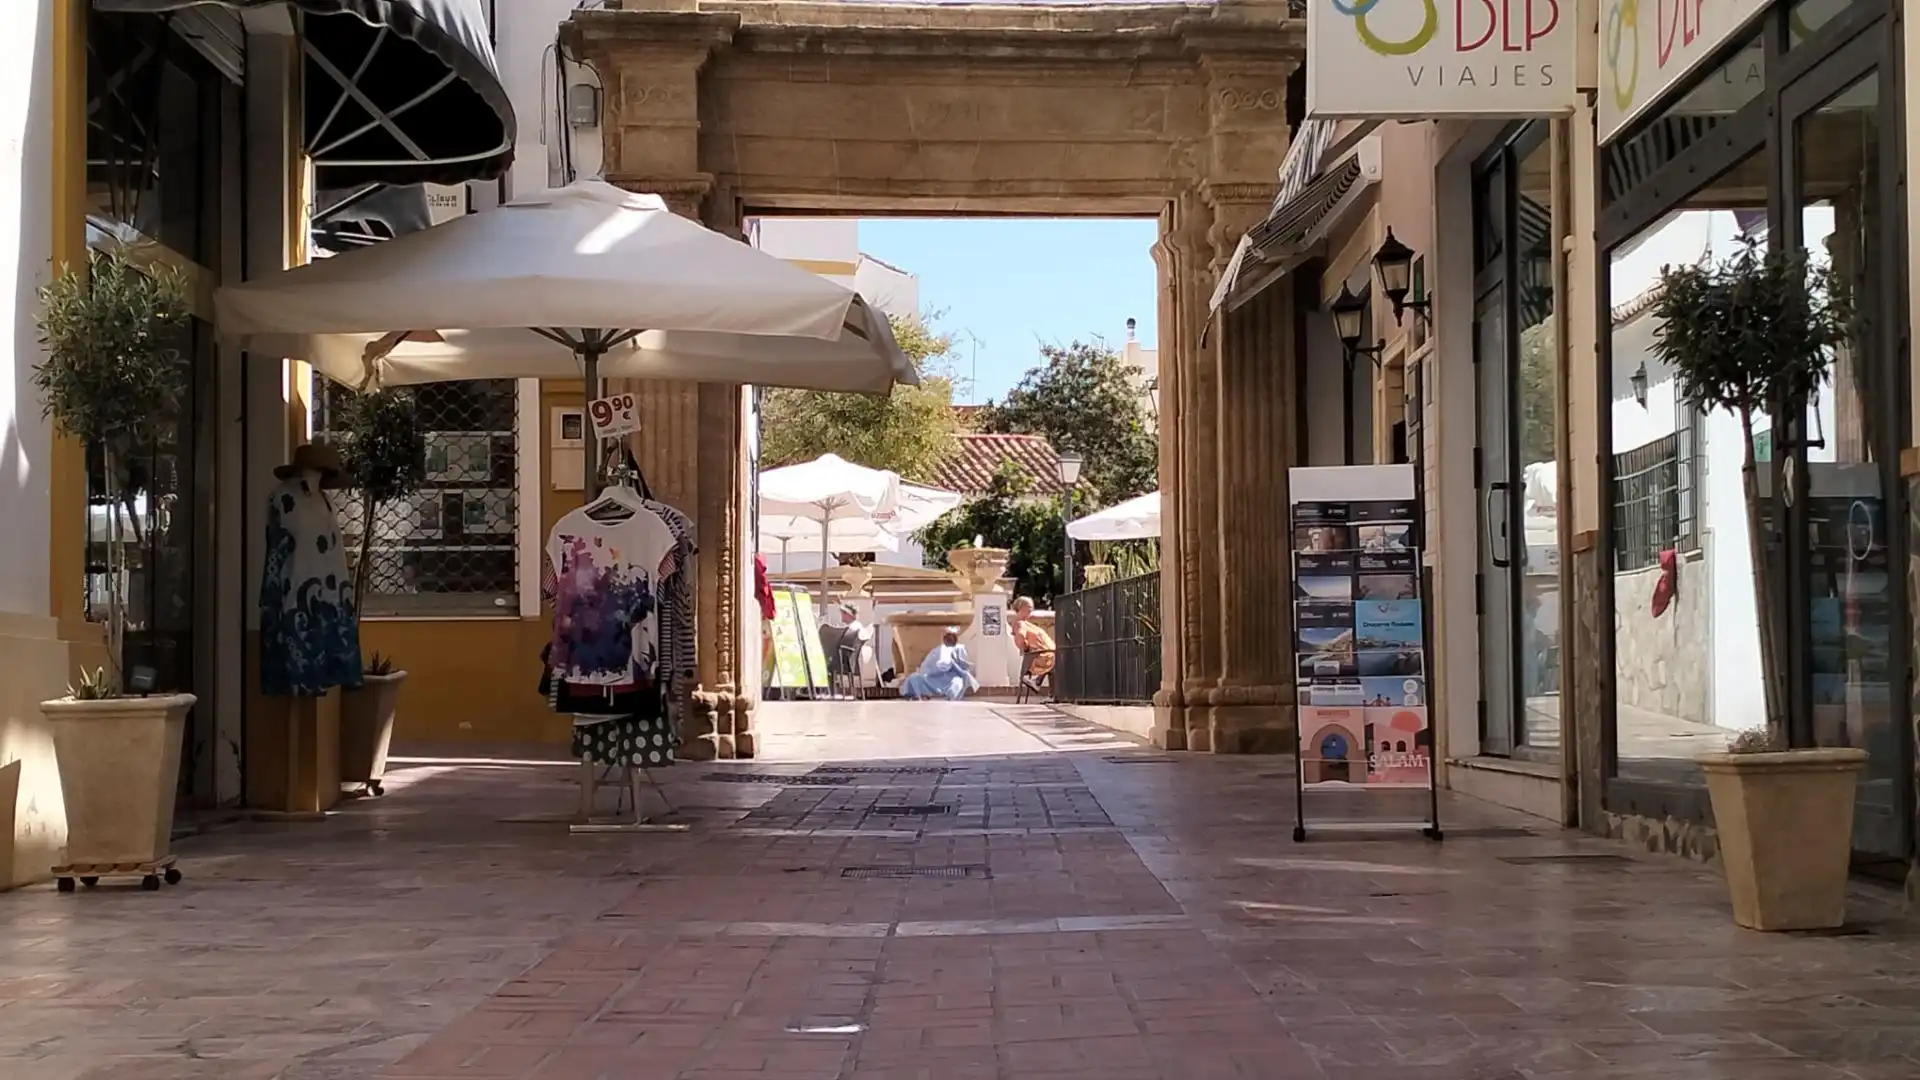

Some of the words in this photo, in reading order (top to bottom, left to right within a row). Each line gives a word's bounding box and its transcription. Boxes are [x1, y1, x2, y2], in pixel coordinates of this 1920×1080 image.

[1455, 0, 1559, 51] DLP
[1407, 65, 1554, 87] VIAJES
[1370, 752, 1425, 769] SALAM
